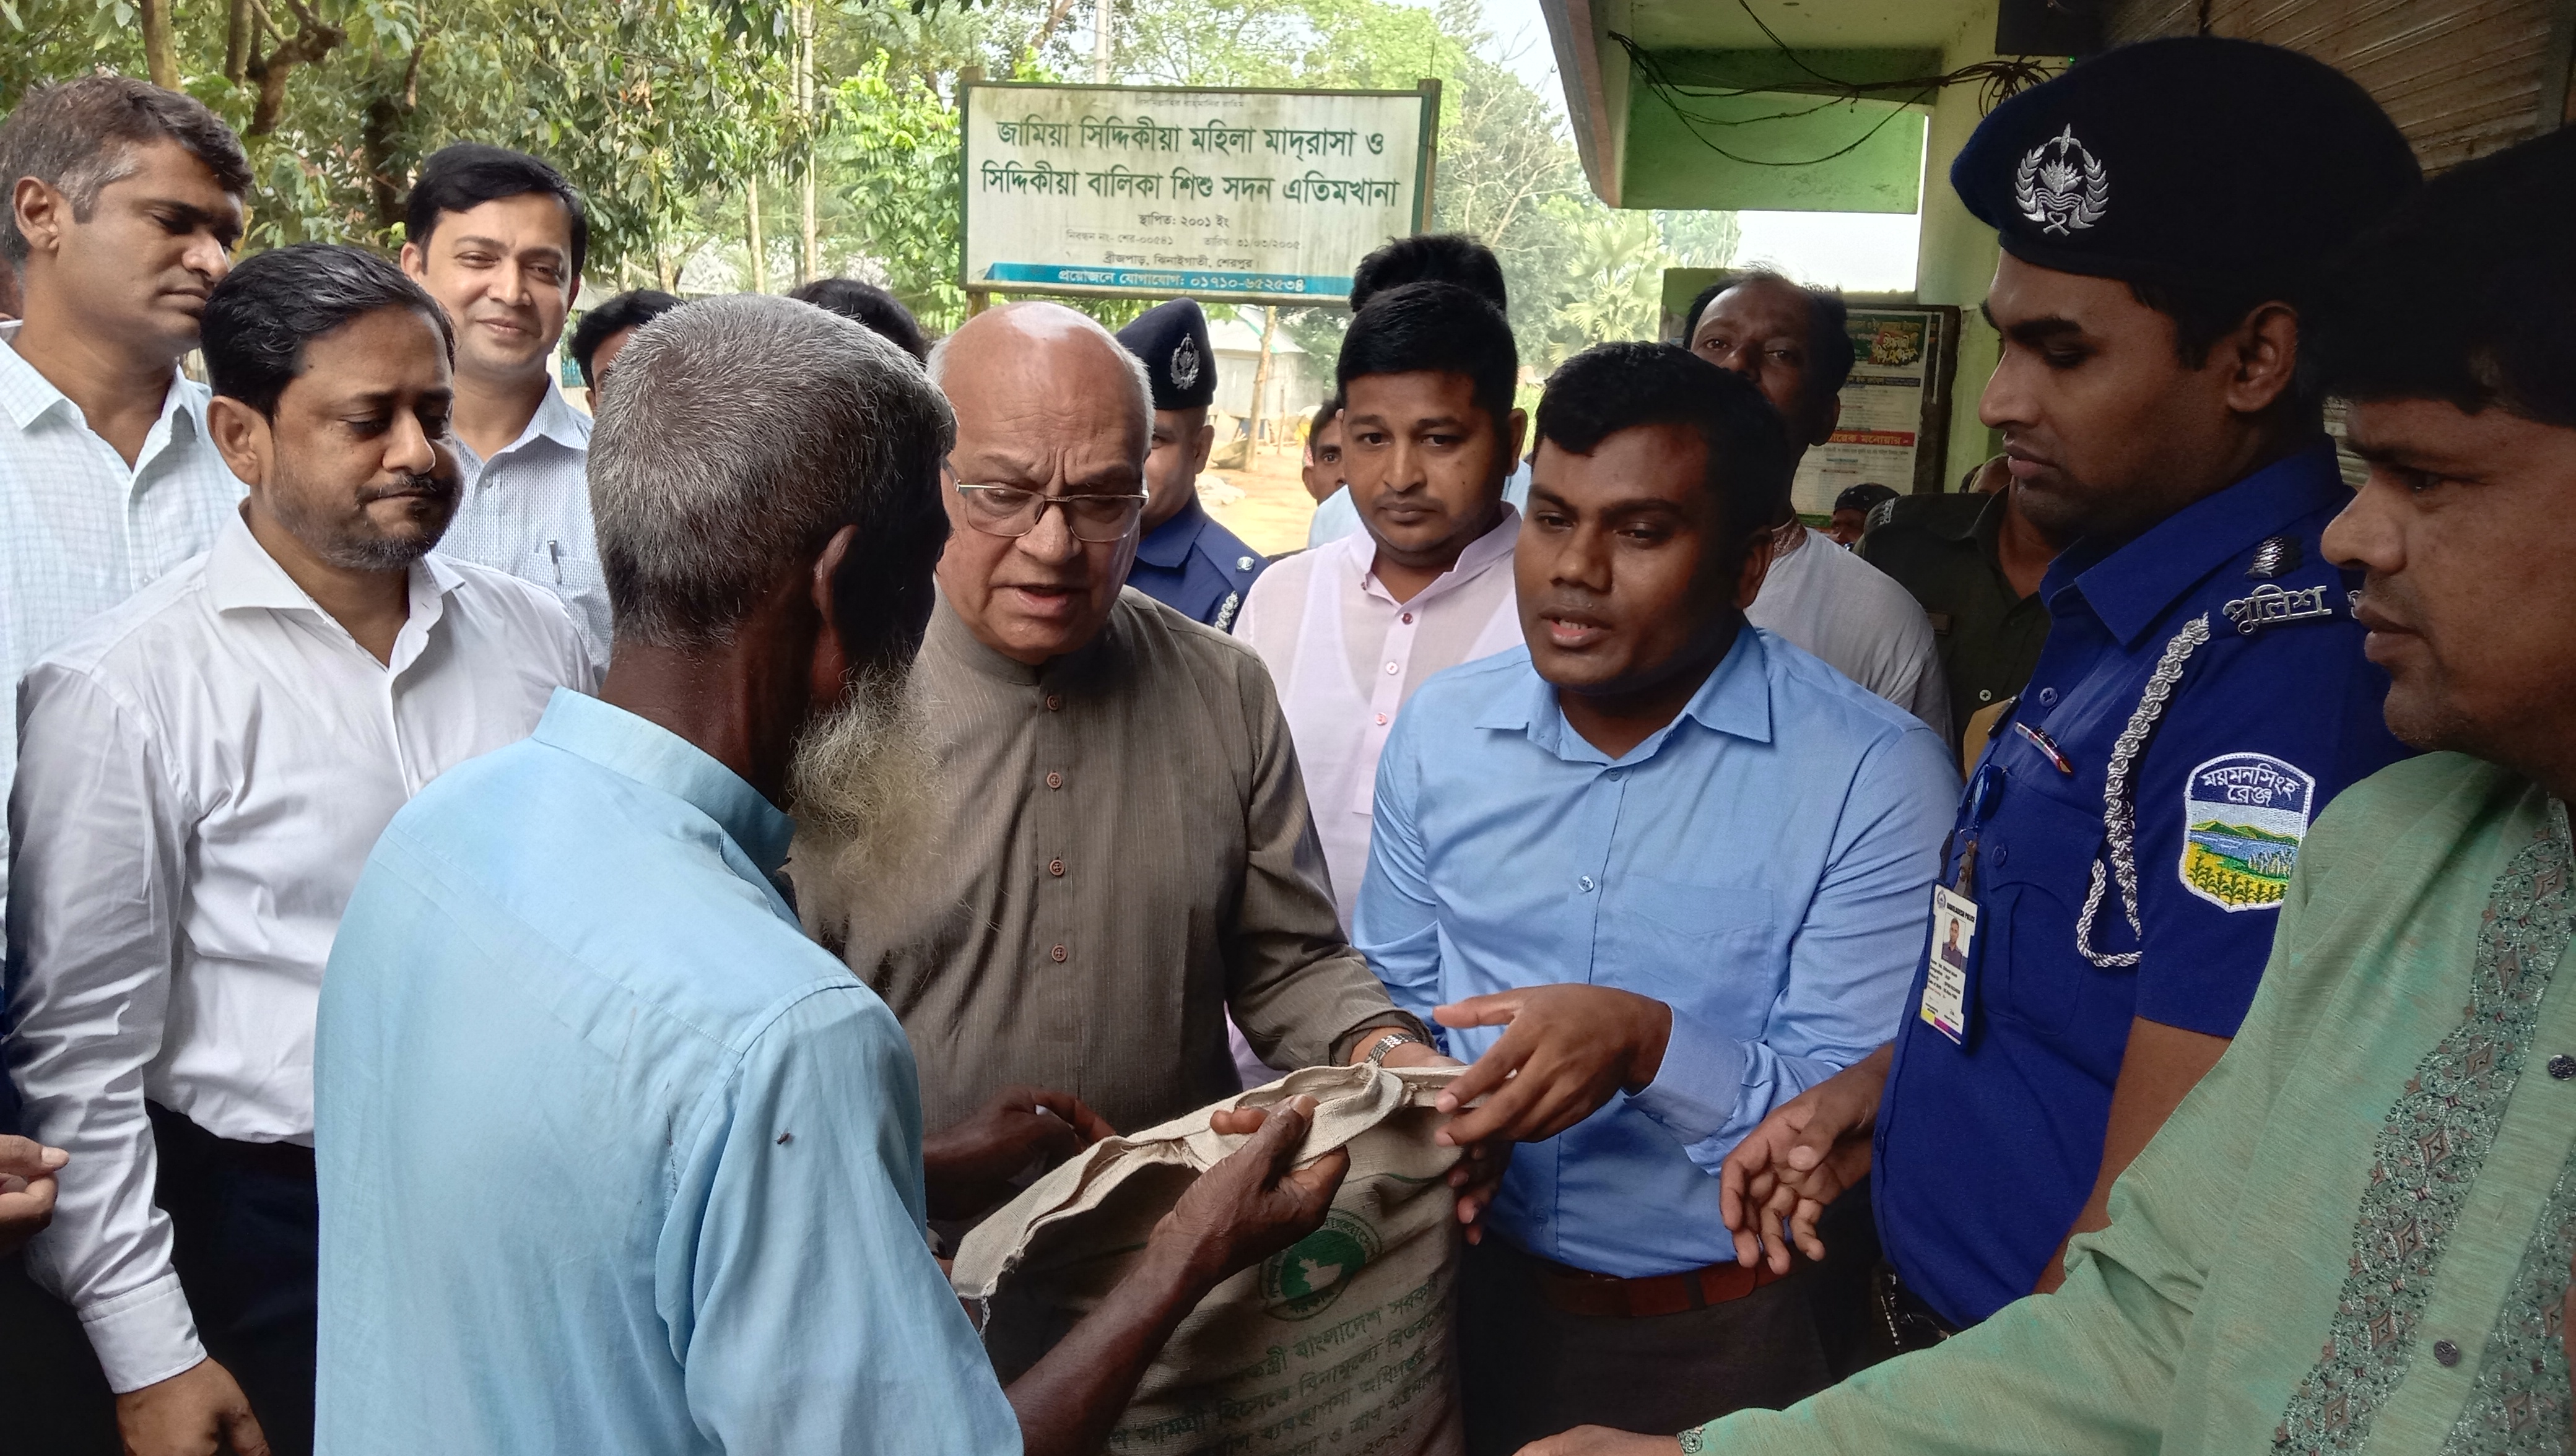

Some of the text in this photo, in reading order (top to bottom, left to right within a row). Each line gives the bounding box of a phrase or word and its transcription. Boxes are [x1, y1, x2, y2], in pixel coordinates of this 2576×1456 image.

[996, 113, 1072, 148] জামিয়া
[1079, 115, 1183, 152] সিদ্দিকীয়া
[1189, 119, 1256, 156] মহিলা
[1366, 132, 1384, 155] ও
[980, 160, 1401, 207] সিদ্দিকীয়া বালিকা শিশু সদন এতিমখানা
[1180, 216, 1211, 227] ২০০১
[1216, 214, 1230, 228] ইং
[1058, 269, 1116, 283] প্রয়োজনে
[2222, 584, 2333, 635] পুলিশ
[2200, 763, 2300, 801] ময়মনসিংহ
[2227, 784, 2273, 807] রেঞ্জ
[1293, 1308, 1382, 1359] বাংলাদেশ
